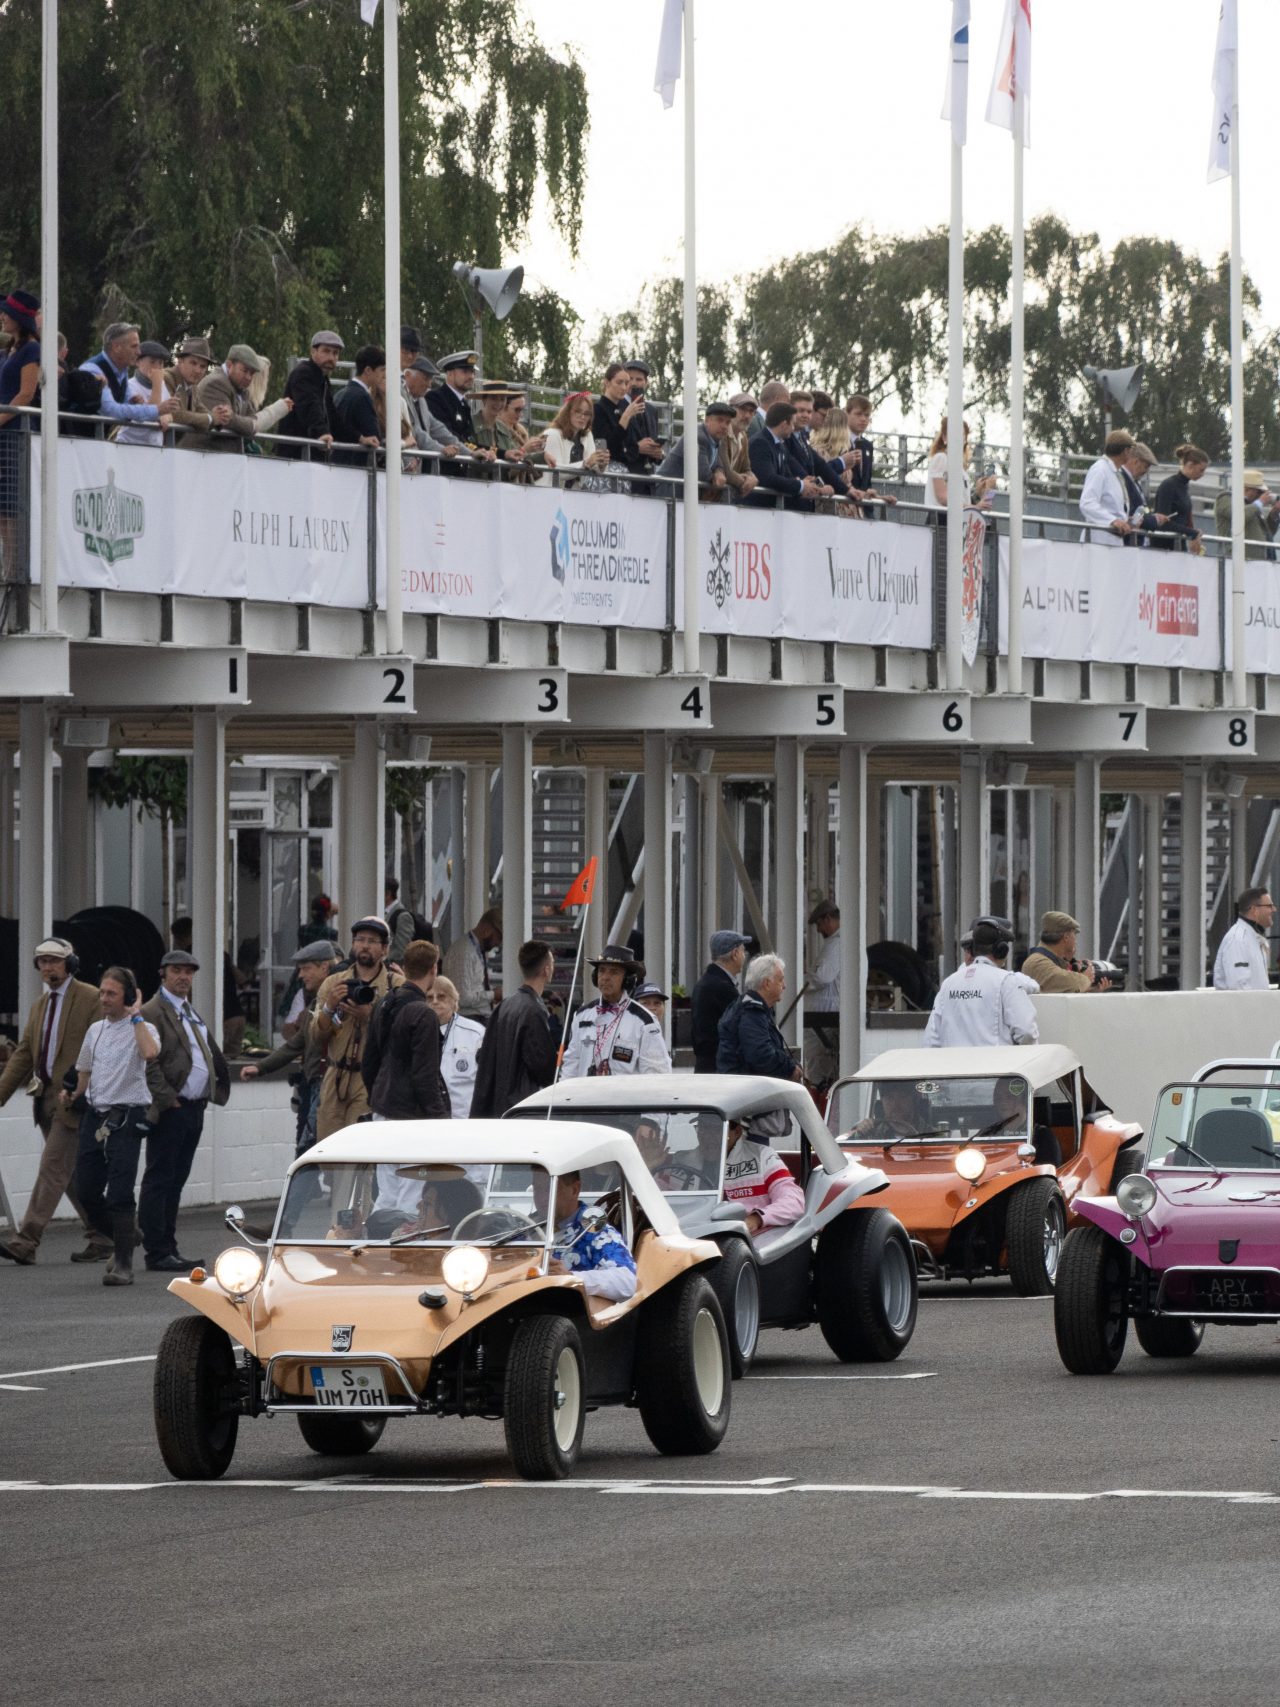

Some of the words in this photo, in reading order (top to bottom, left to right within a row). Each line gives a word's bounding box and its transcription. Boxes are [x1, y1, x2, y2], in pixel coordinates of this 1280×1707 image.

[288, 515, 350, 552] LAUREN
[401, 569, 474, 596] EDMISTON
[572, 552, 650, 584] THREADNEEDLE
[734, 541, 771, 600] UBS
[826, 546, 863, 600] Veuve
[1022, 585, 1089, 614] ALPINE
[1139, 583, 1155, 630] sky
[1158, 591, 1199, 625] cinema
[228, 657, 238, 694] 1
[382, 667, 406, 704] 2
[537, 677, 559, 713] 3
[680, 686, 704, 719] 4
[816, 693, 836, 726] 5
[942, 701, 963, 733] 6
[1118, 711, 1138, 742] 7
[1228, 717, 1248, 747] 8
[949, 990, 982, 1000] MARSHAL
[1208, 1293, 1253, 1307] 145A
[1211, 1278, 1247, 1292] APY
[341, 1369, 355, 1387] S
[317, 1389, 343, 1406] UM
[346, 1389, 385, 1406] 70H
